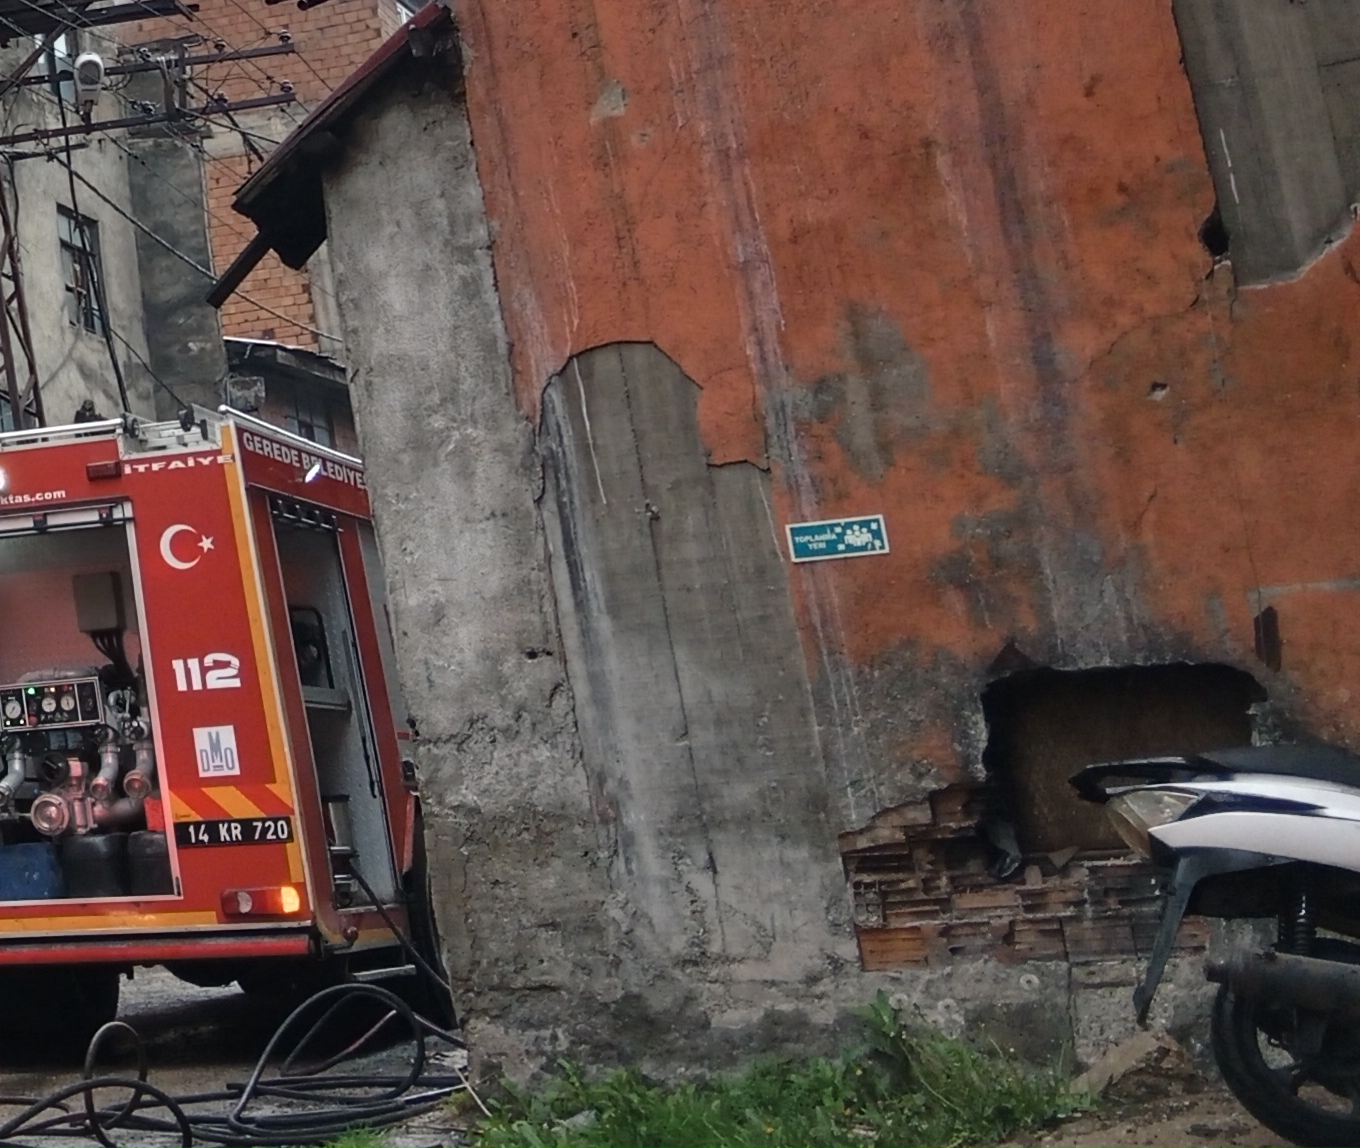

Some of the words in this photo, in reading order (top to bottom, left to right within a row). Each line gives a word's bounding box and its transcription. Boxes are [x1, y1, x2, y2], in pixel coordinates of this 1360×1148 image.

[242, 432, 301, 468] GEREDE
[172, 652, 242, 692] 112
[188, 824, 209, 845] 14
[219, 822, 242, 842] KR
[252, 820, 289, 840] 720
